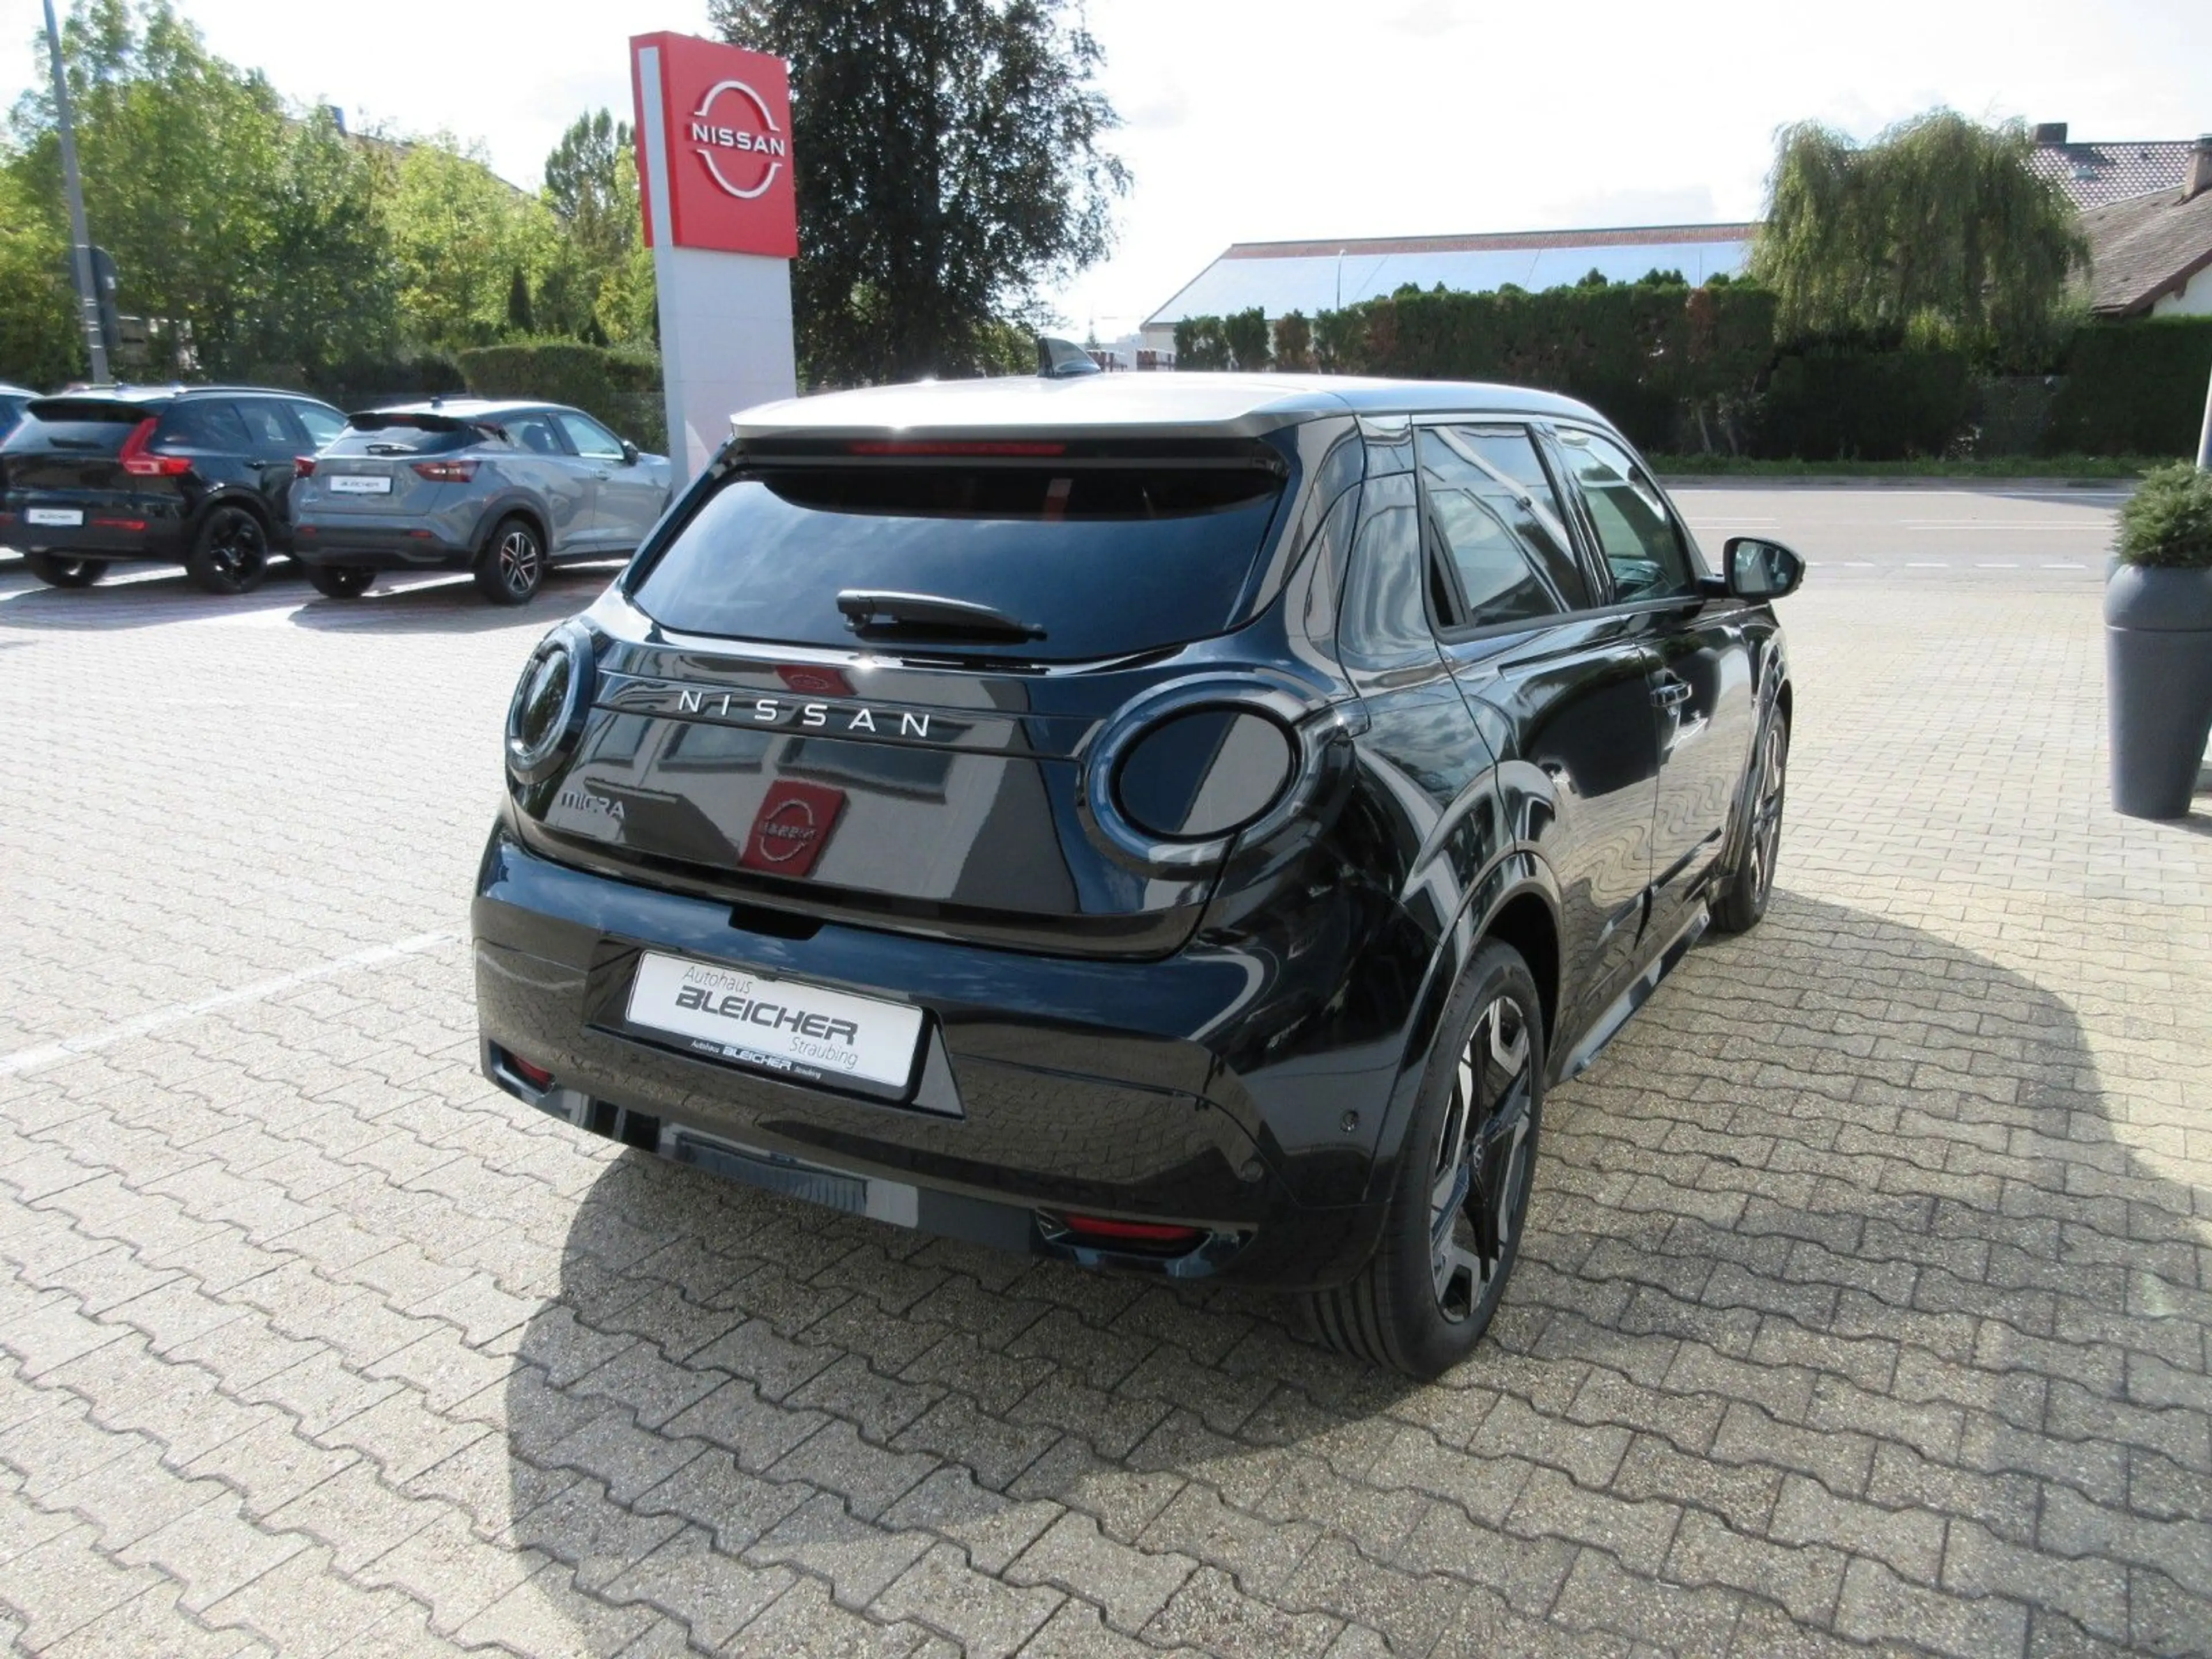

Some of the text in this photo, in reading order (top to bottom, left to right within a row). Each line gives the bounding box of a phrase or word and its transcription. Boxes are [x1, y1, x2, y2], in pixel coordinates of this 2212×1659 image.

[692, 122, 785, 157] NISSAN
[678, 690, 930, 738] NISSAN
[681, 965, 753, 994] Autohaus
[675, 984, 858, 1046] BLEICHER
[722, 1046, 793, 1071] BLEICHER
[789, 1036, 858, 1070] Straubing
